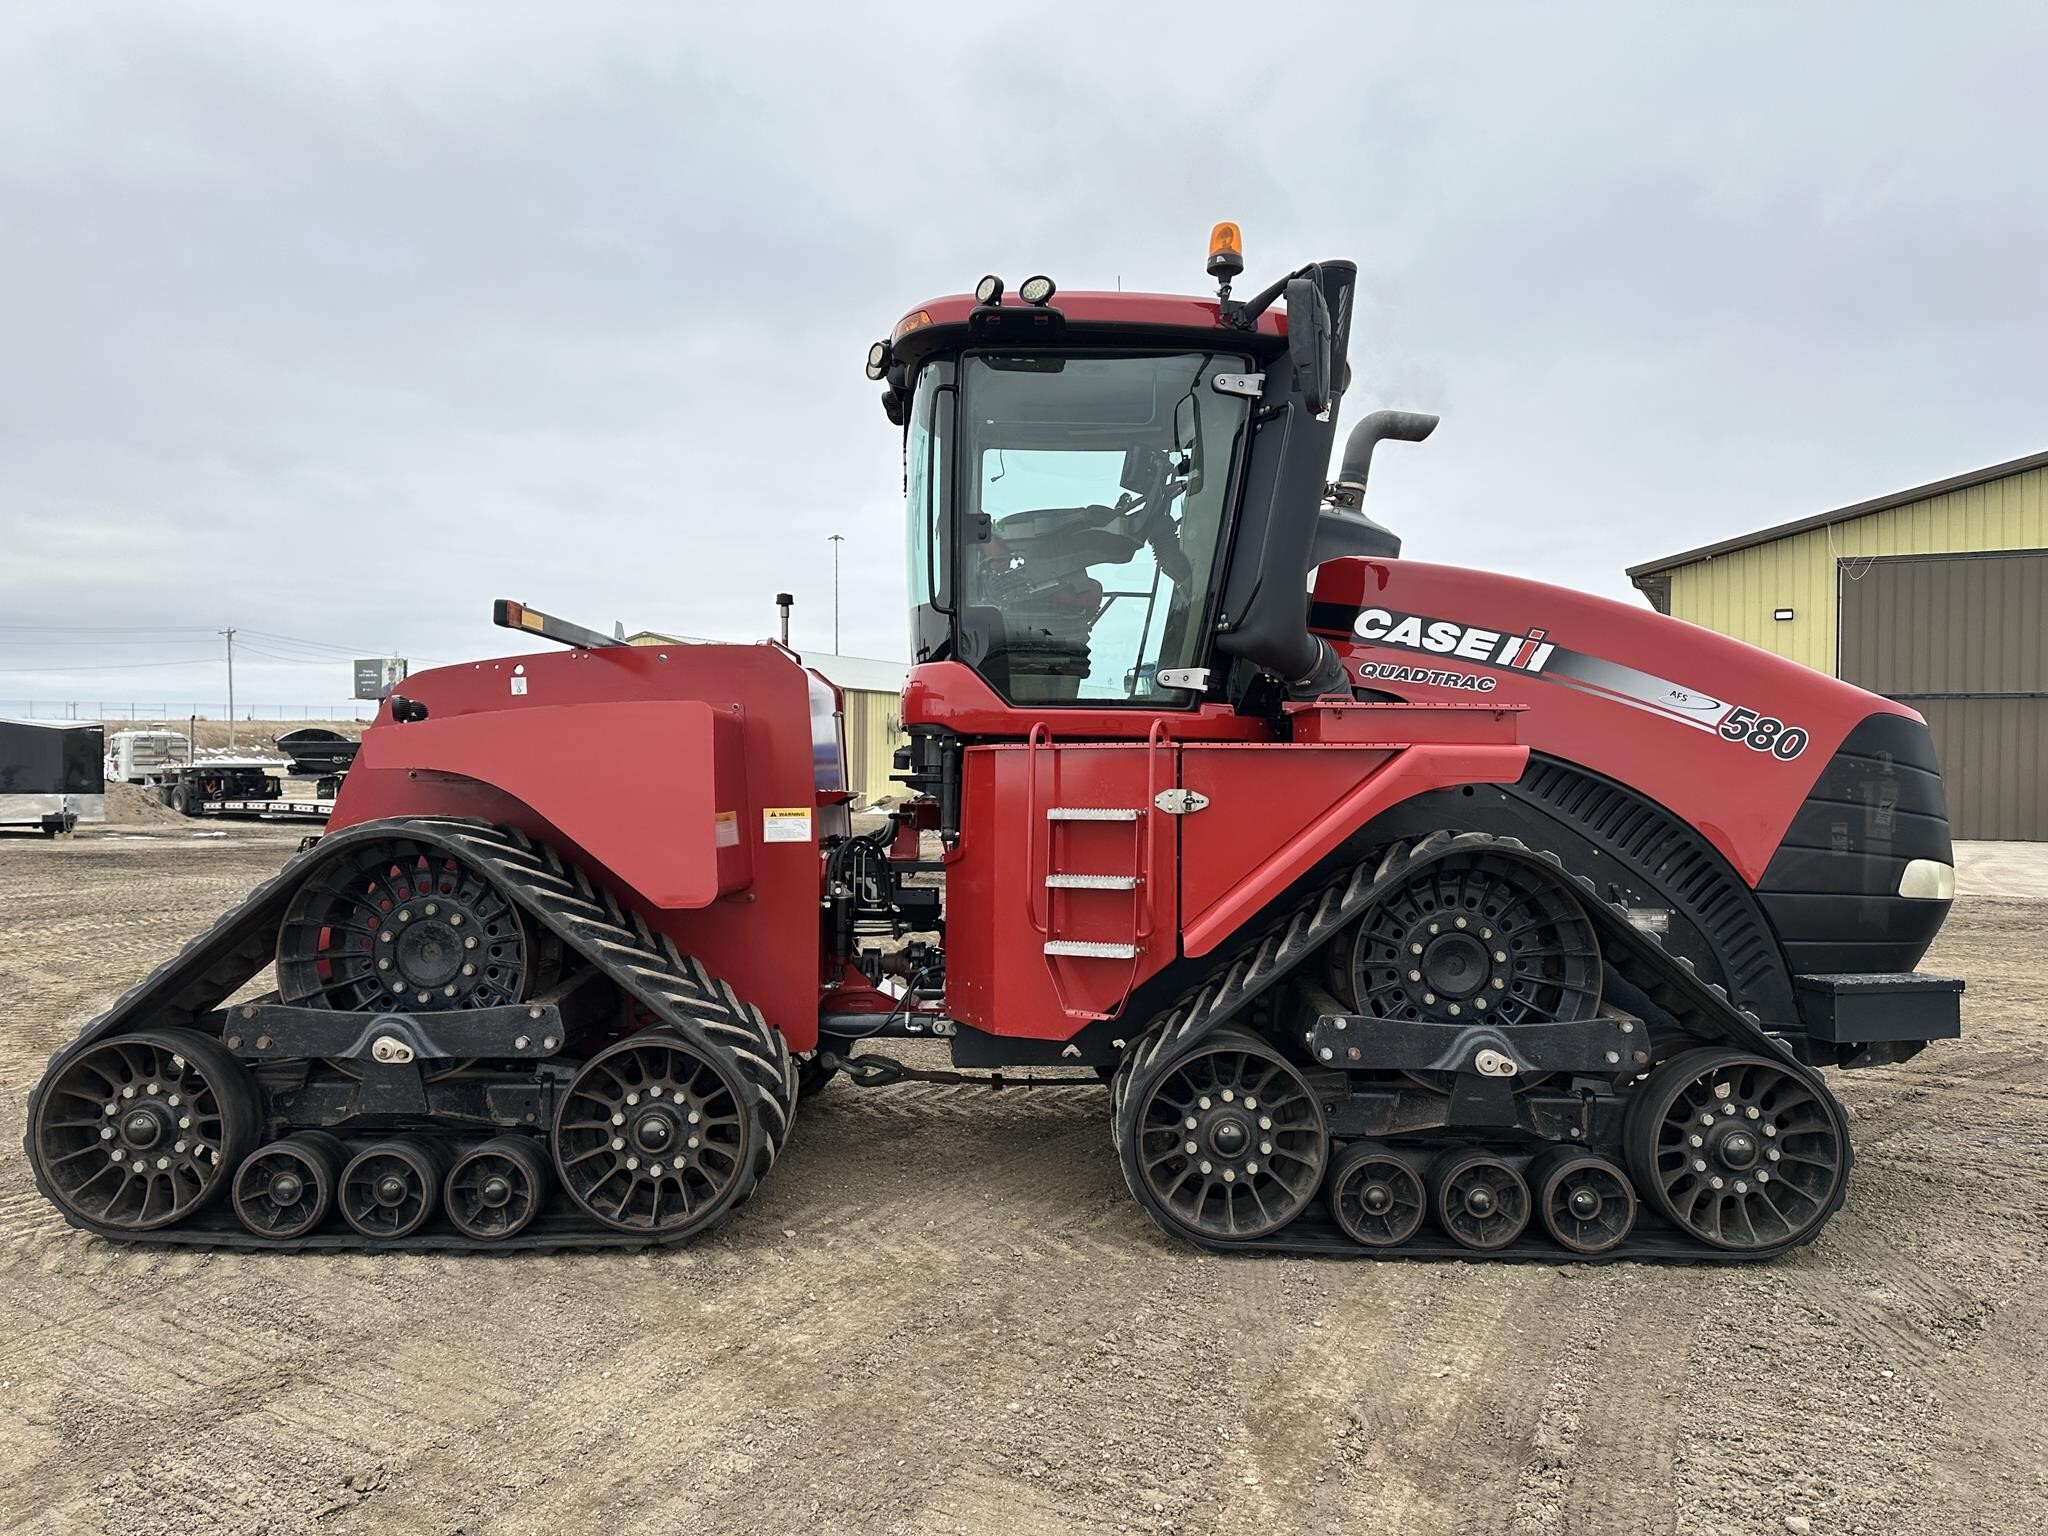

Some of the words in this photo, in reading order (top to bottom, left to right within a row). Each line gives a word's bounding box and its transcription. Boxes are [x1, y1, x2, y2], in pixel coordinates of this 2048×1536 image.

[1353, 609, 1501, 661] CASE
[1359, 662, 1497, 693] QUADTRAC
[1670, 690, 1688, 702] AFS
[1719, 705, 1810, 762] 580
